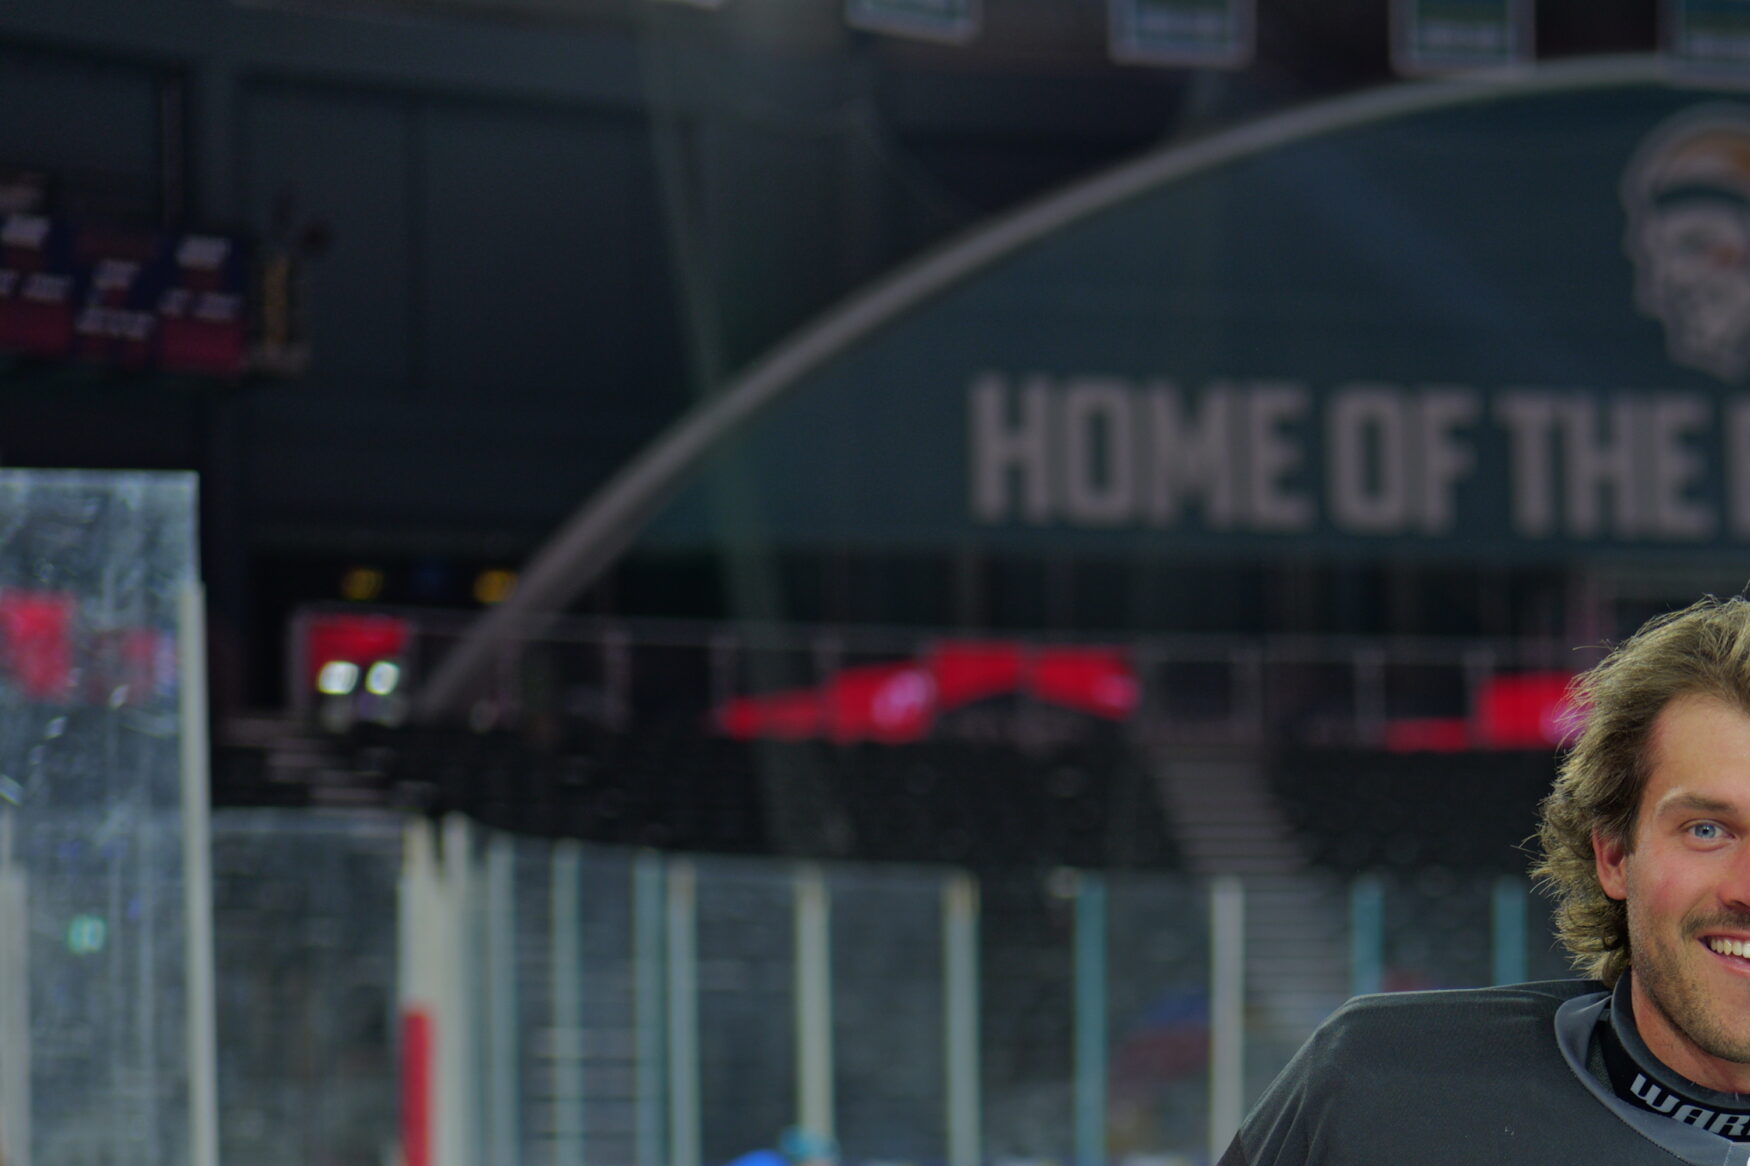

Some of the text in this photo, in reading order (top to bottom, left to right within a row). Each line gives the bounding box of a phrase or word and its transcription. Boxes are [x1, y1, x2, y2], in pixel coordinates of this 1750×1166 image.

[972, 374, 1312, 529] HOME
[1328, 383, 1478, 532] OF
[1500, 393, 1715, 539] THE
